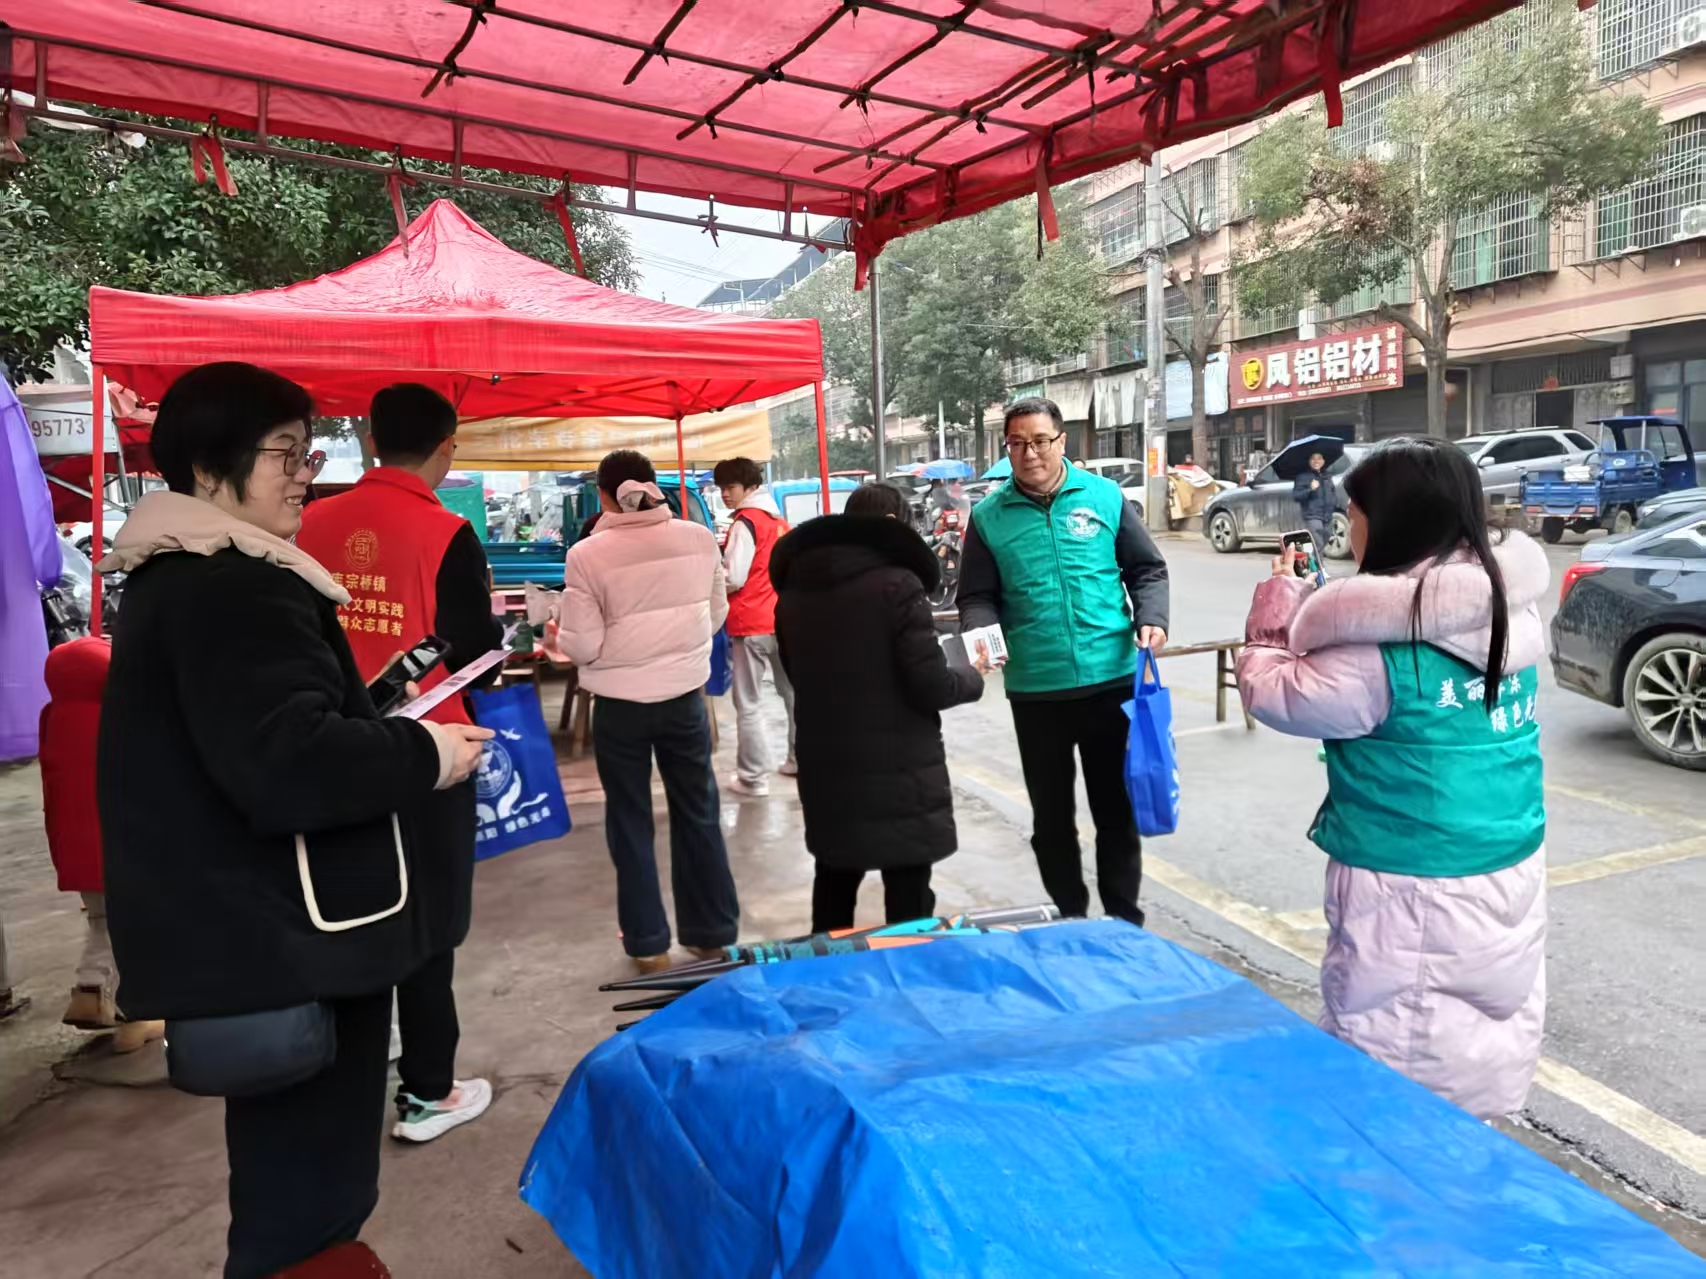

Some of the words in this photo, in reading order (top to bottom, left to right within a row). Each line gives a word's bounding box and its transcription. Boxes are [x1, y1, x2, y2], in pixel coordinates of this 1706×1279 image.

[1266, 333, 1382, 389] 凤铝铝材
[31, 418, 86, 437] 95773
